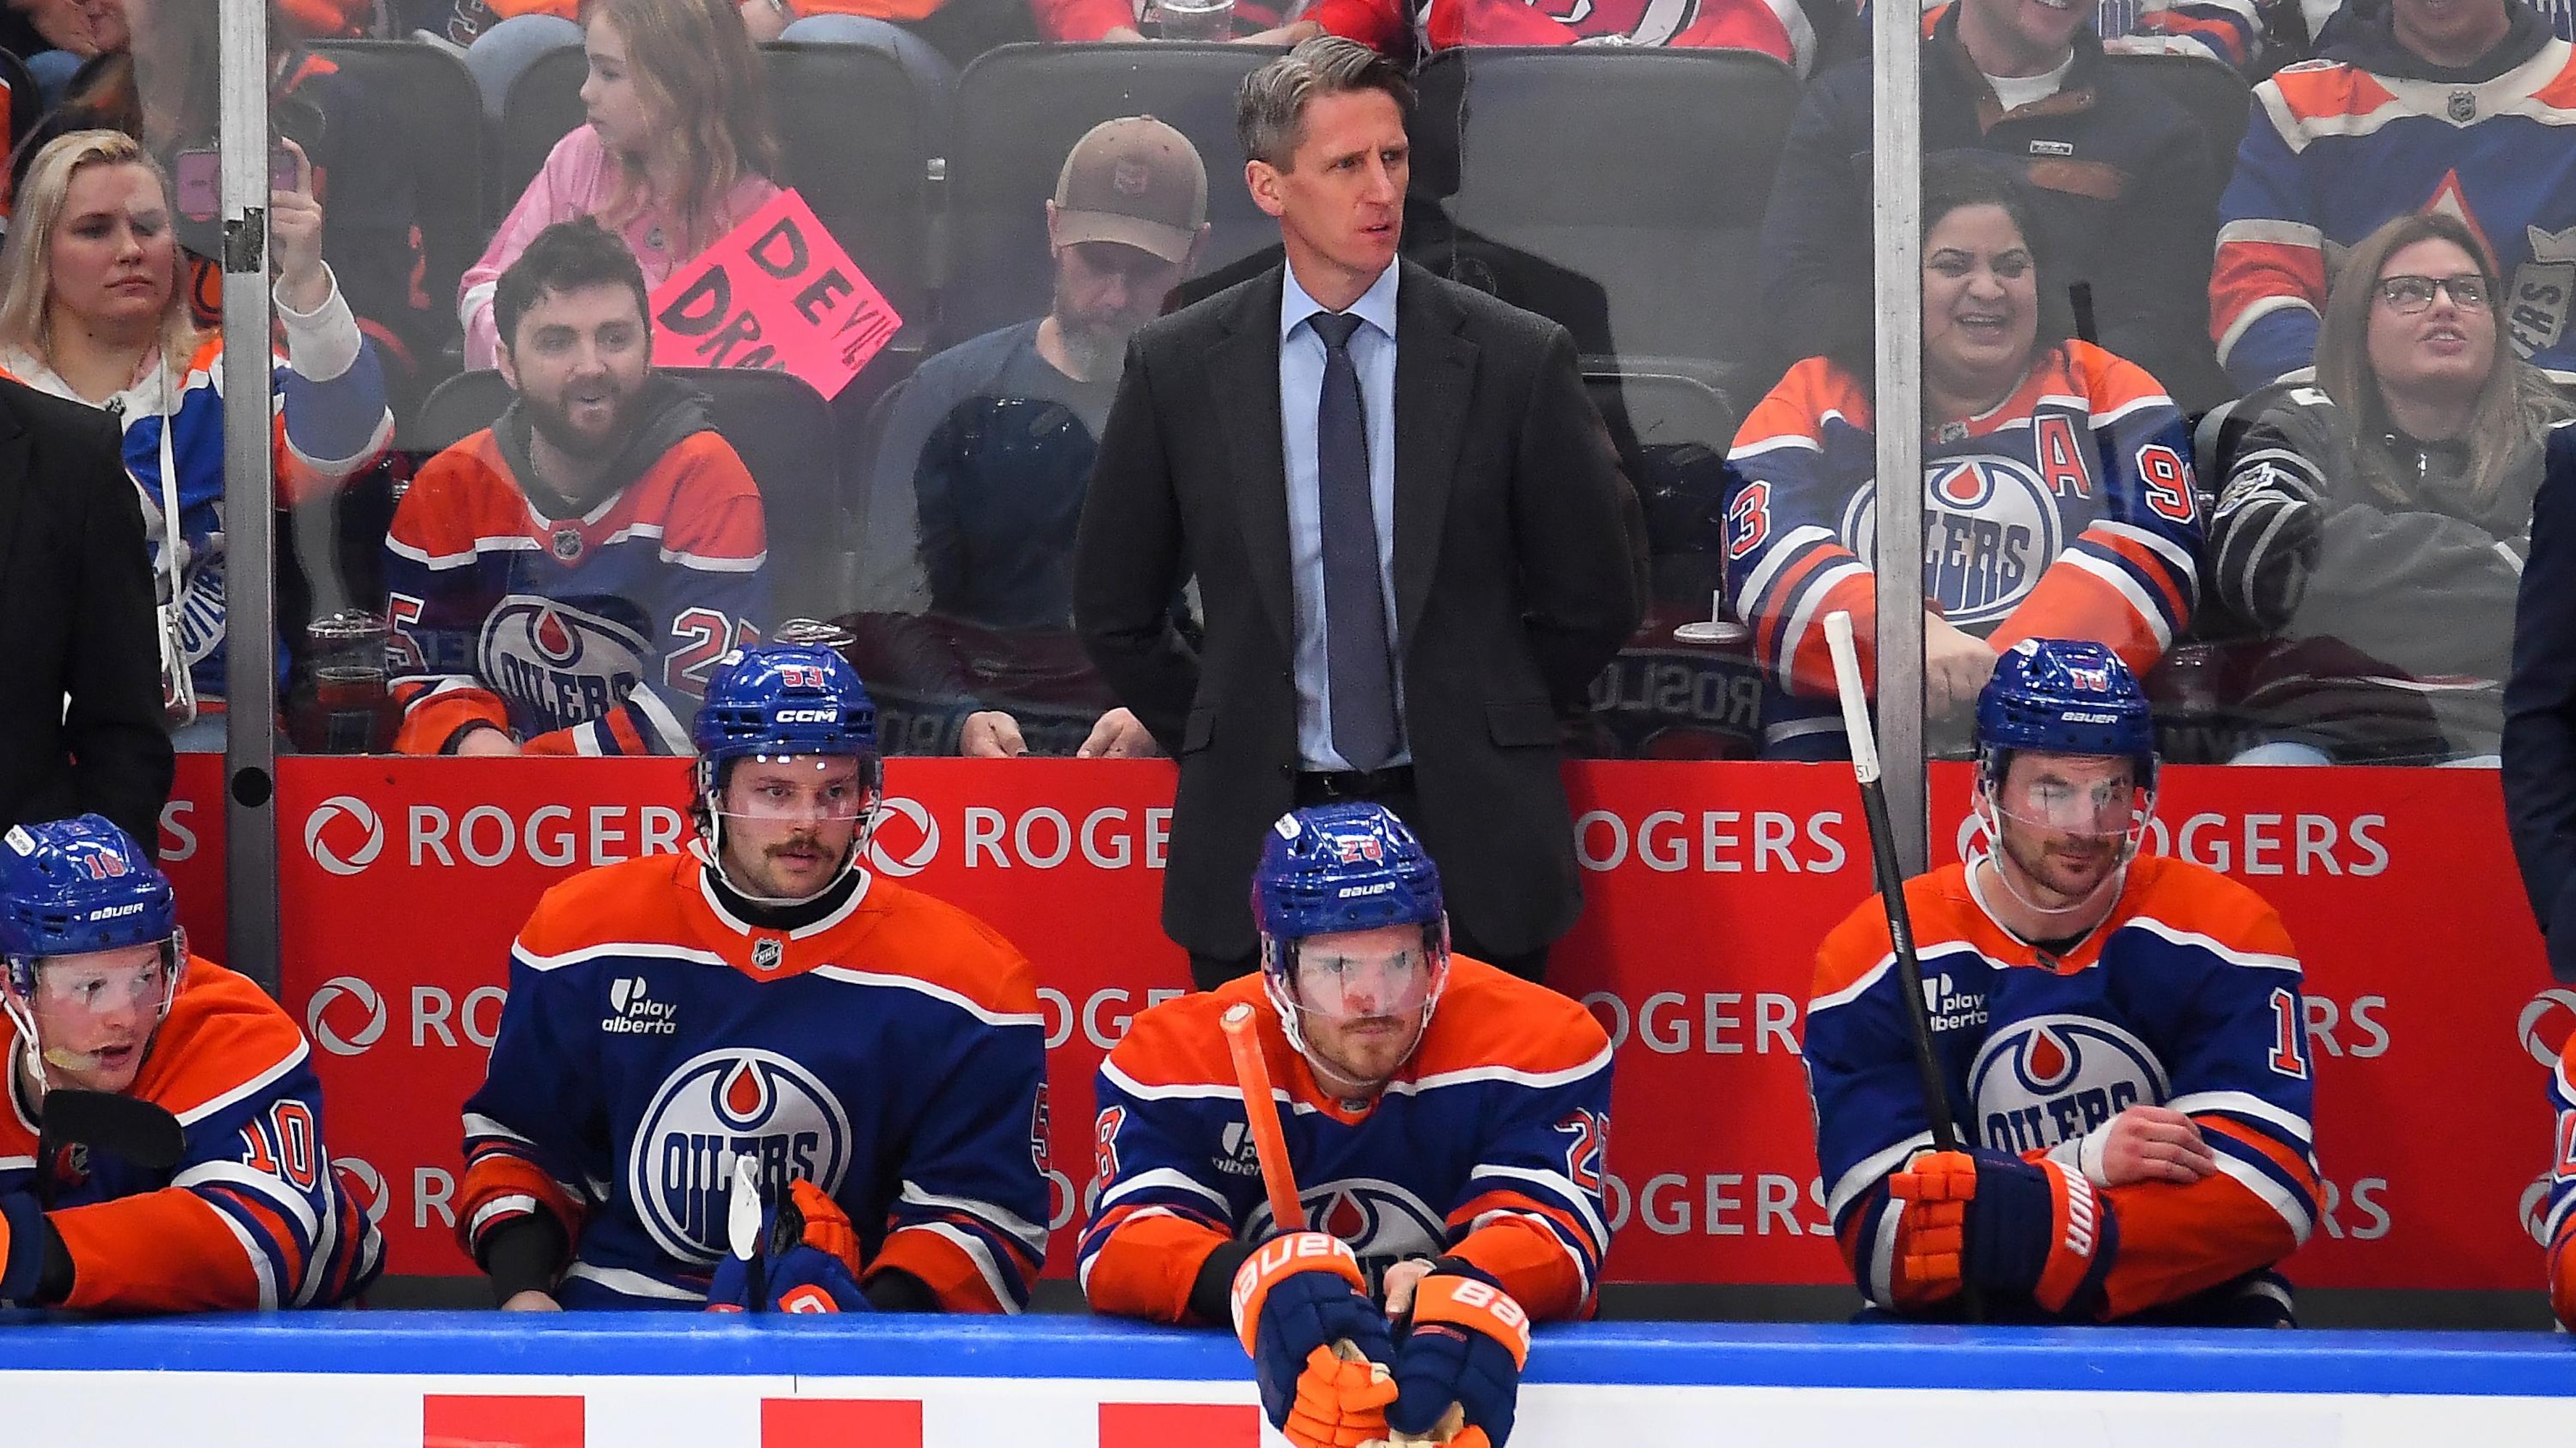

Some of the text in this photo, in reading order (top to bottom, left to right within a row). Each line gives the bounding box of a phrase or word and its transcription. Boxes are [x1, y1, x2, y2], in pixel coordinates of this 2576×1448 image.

[2034, 414, 2091, 500] A
[2136, 444, 2197, 524] 9
[1727, 479, 1771, 560] 3
[781, 666, 824, 688] 53
[776, 710, 837, 723] CCM
[2061, 711, 2118, 724] BAUER
[84, 852, 126, 880] 10
[408, 804, 684, 868] ROGER
[964, 807, 1174, 869] ROGE
[1574, 809, 1845, 874] OGERS
[601, 1016, 676, 1035] alberta
[629, 997, 677, 1017] play
[1579, 991, 1803, 1055] OGER
[1929, 1010, 1988, 1032] lberta
[1942, 993, 1985, 1016] play
[240, 1098, 315, 1193] 10
[1096, 1106, 1127, 1190] 8
[1553, 1106, 1611, 1199] 2
